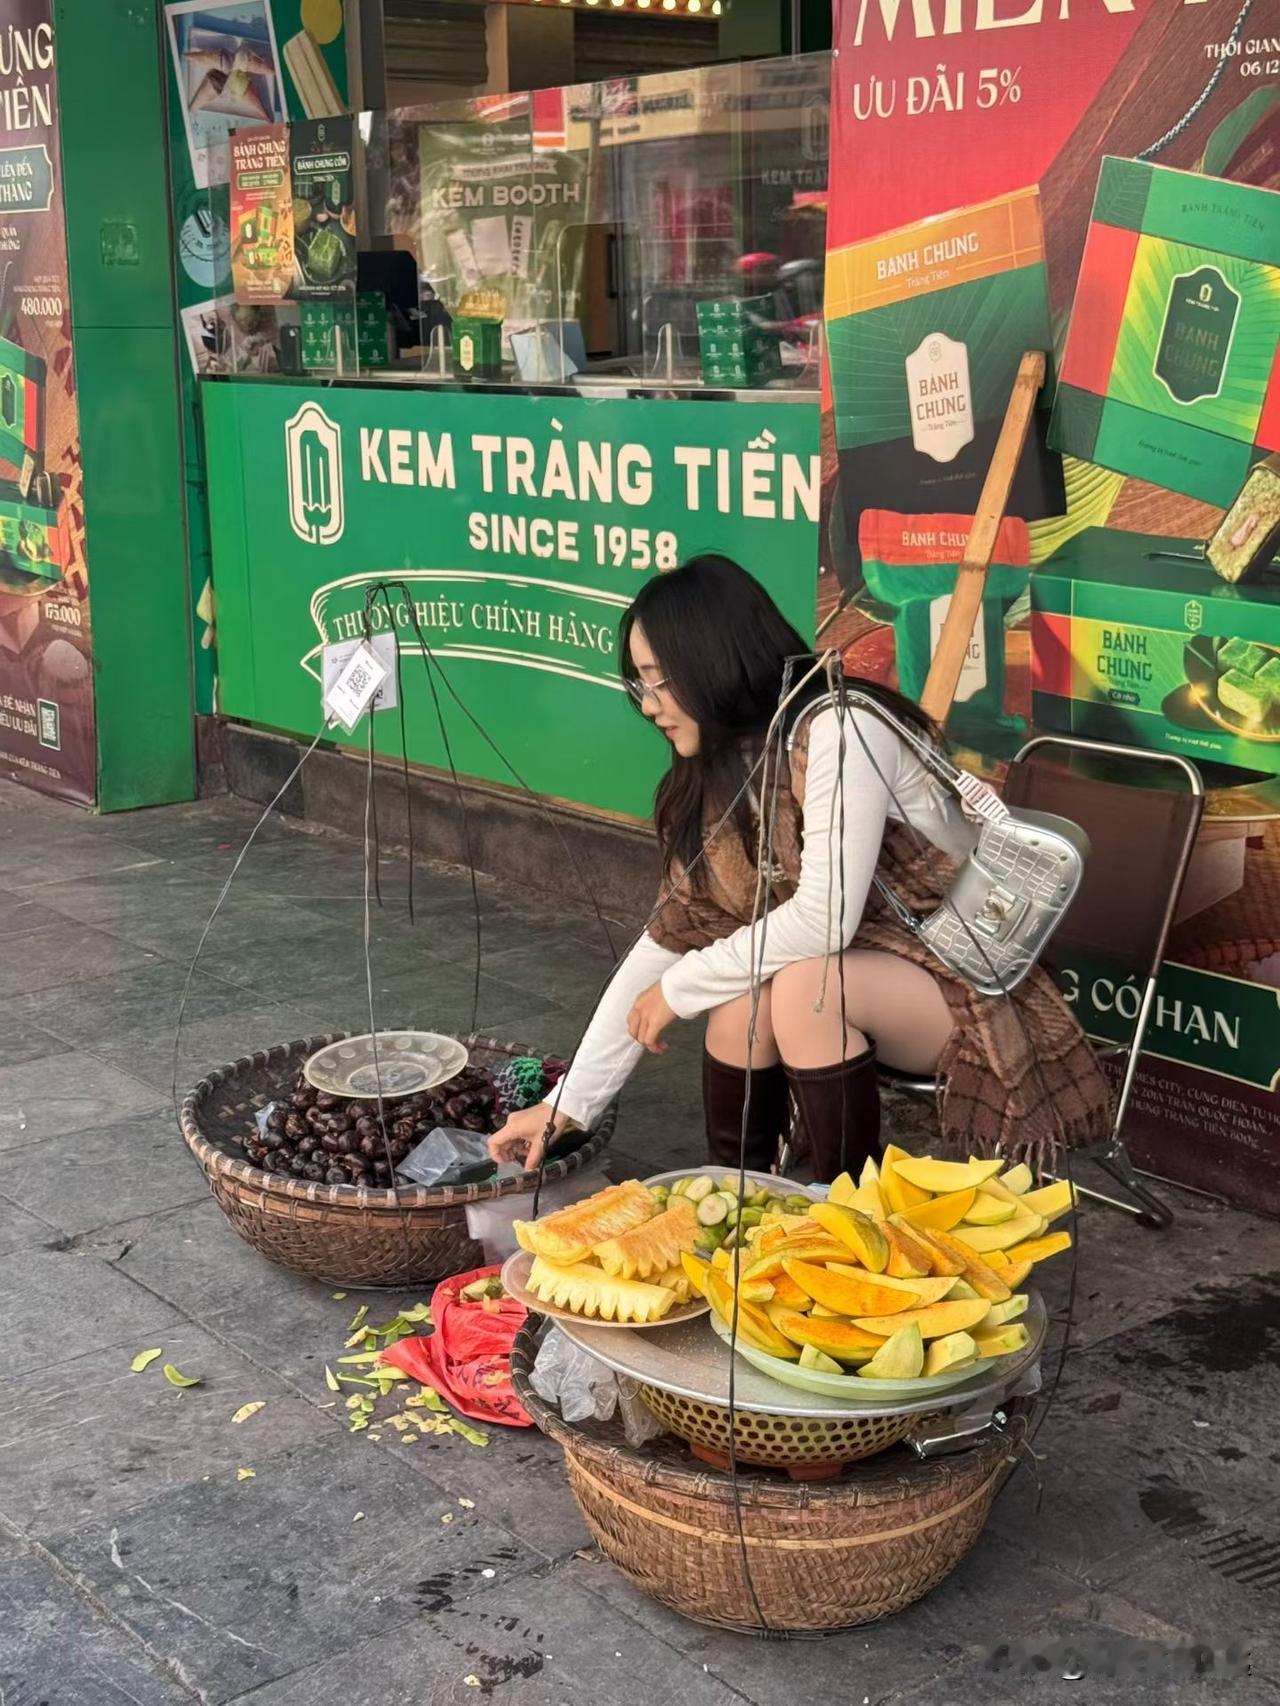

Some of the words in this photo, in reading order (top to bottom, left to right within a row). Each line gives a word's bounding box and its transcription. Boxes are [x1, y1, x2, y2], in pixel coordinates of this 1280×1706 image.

[0, 71, 52, 131] IỀN
[853, 75, 896, 120] ƯU
[906, 63, 965, 115] ĐÃI
[976, 66, 1022, 109] 5%
[492, 183, 581, 207] BOOTH
[21, 296, 63, 316] 480.000
[359, 427, 456, 489] KEM
[471, 417, 652, 506] TRÀNG
[674, 428, 819, 523] TIỀN
[468, 512, 580, 562] SINCE
[593, 523, 679, 573] 1958
[413, 593, 465, 633] HIỆU
[471, 599, 541, 638] CHÍNH
[1091, 974, 1142, 1020] CÓ
[1155, 994, 1240, 1050] HẠN
